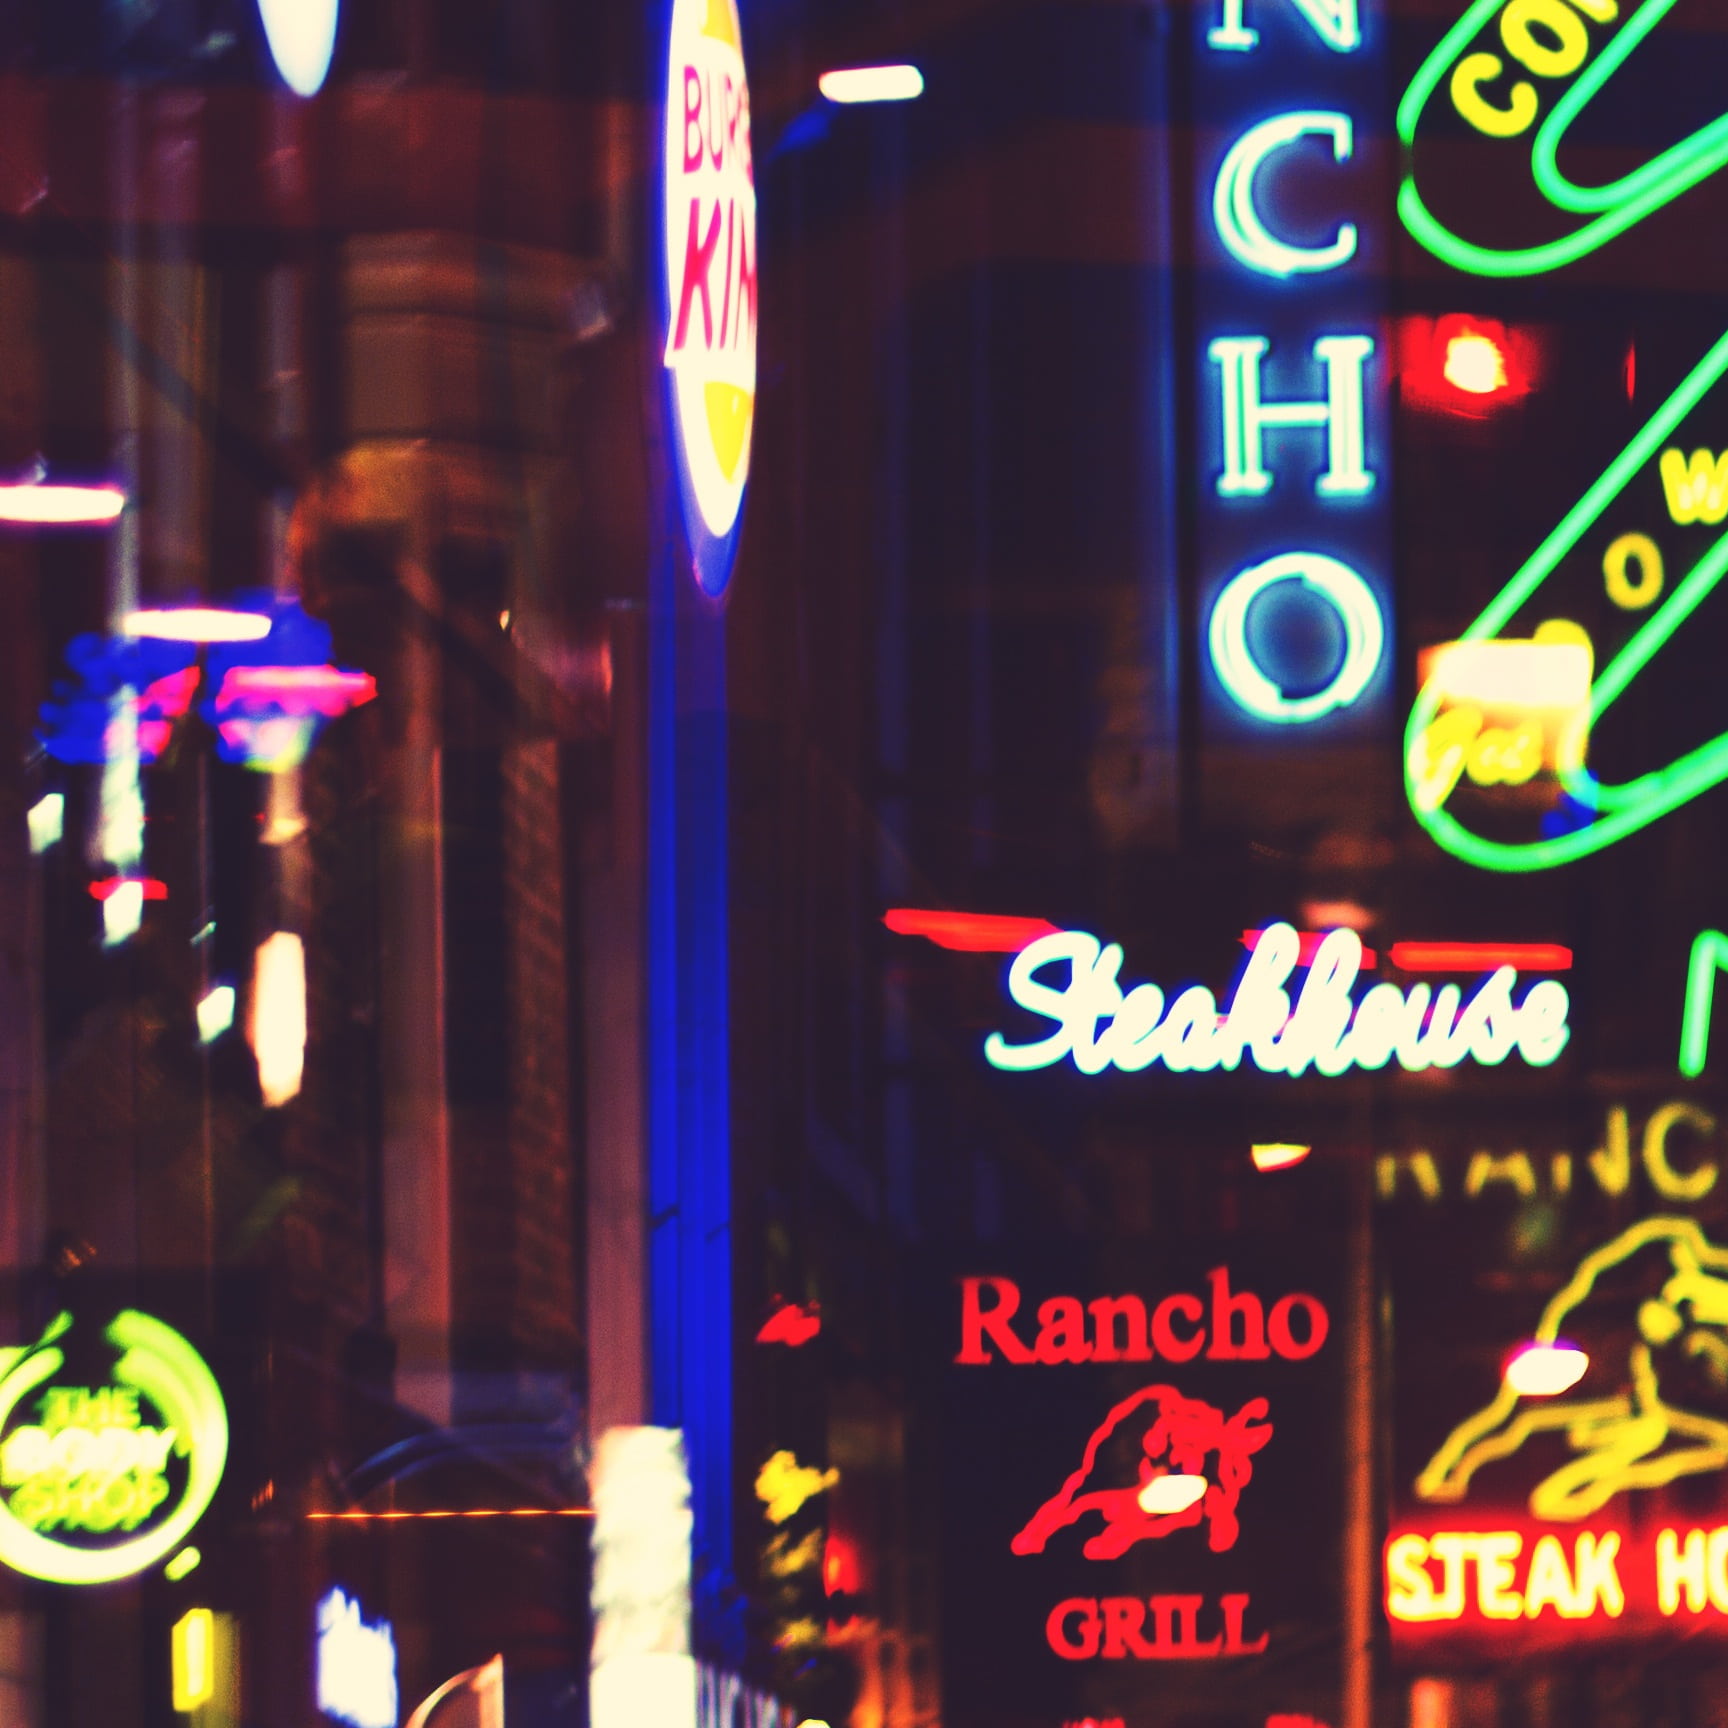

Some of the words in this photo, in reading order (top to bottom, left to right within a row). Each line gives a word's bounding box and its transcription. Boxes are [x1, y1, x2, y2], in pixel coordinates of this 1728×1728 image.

[984, 921, 1572, 1077] Steakhouse
[955, 1266, 1330, 1366] Rancho
[1386, 1531, 1627, 1623] STEAK
[1044, 1593, 1270, 1661] GRILL
